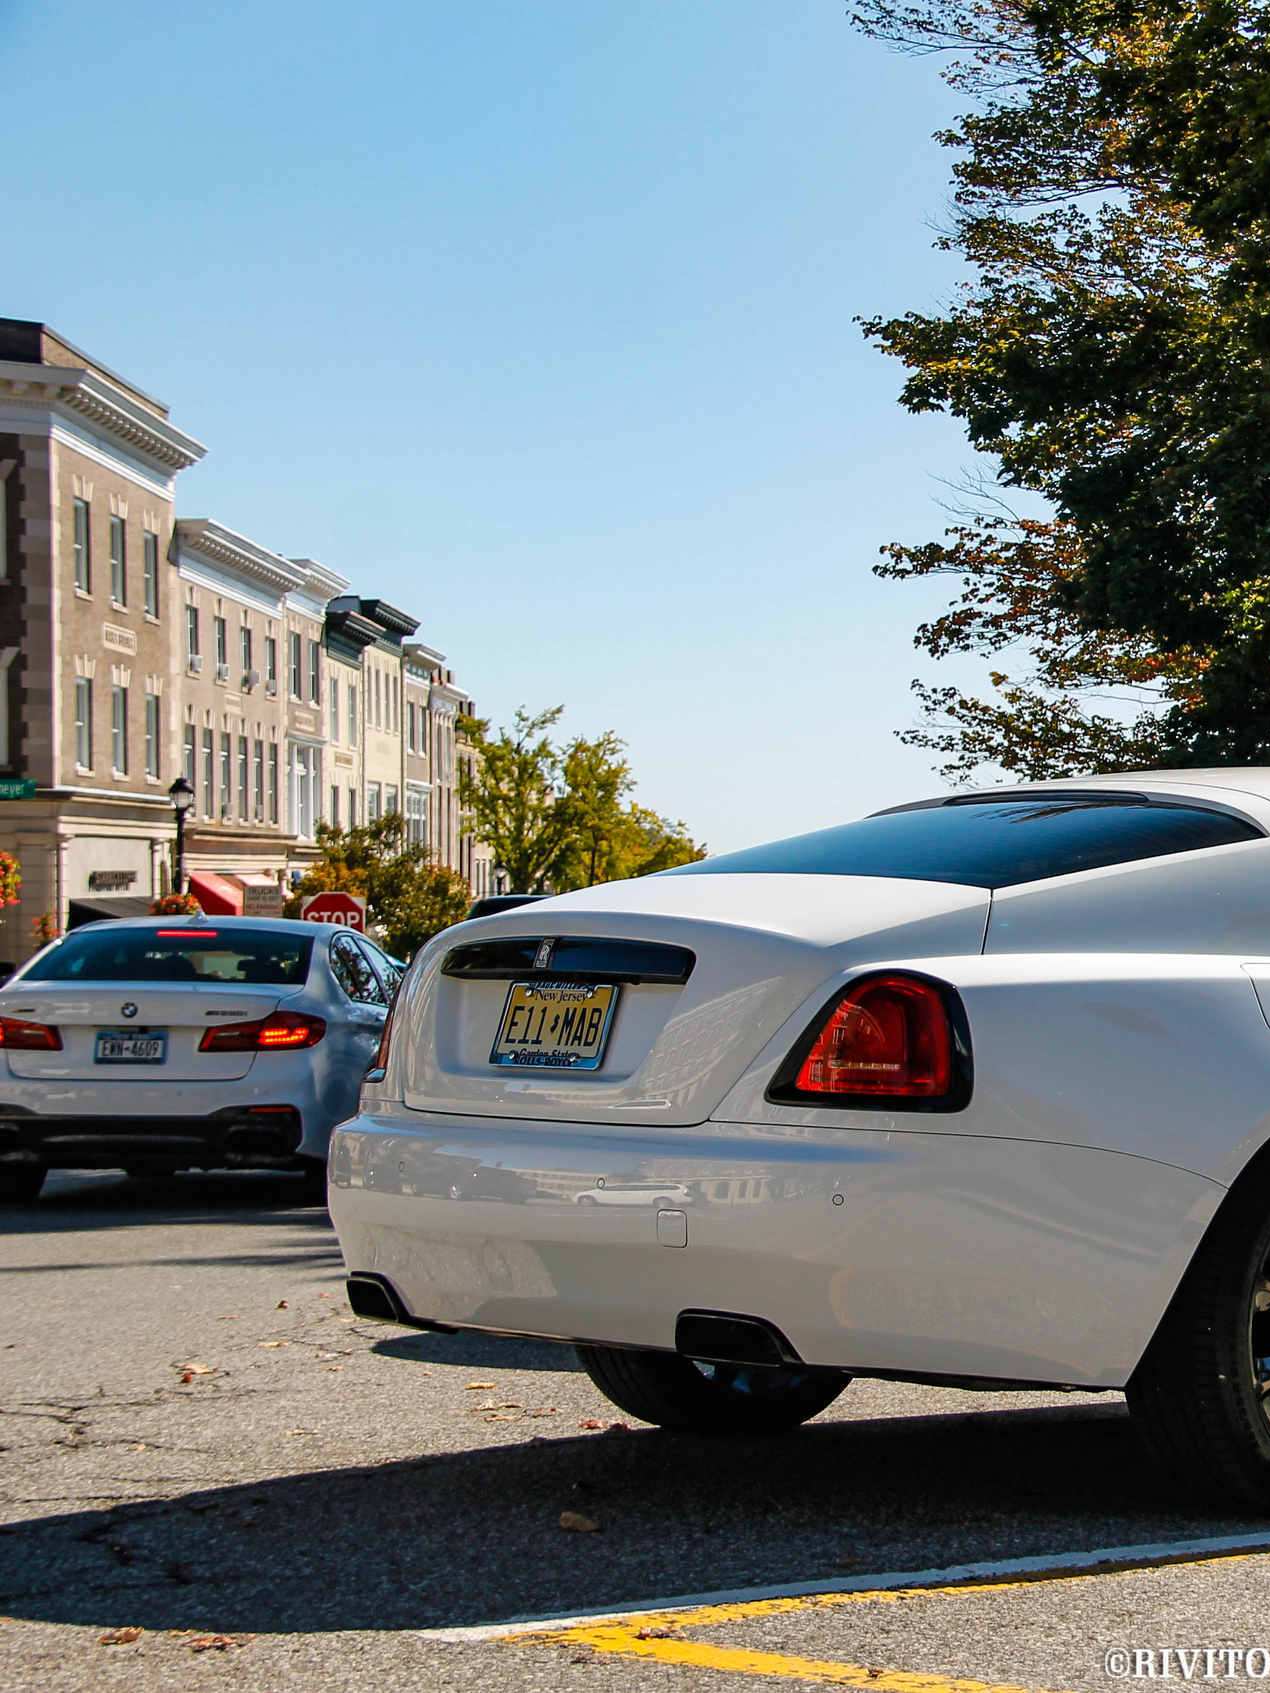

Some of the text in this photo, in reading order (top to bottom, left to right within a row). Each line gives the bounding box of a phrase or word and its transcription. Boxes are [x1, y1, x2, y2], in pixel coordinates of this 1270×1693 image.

[307, 911, 360, 930] STOP
[535, 990, 588, 1004] New Jersey
[505, 1005, 602, 1046] E11 MAB
